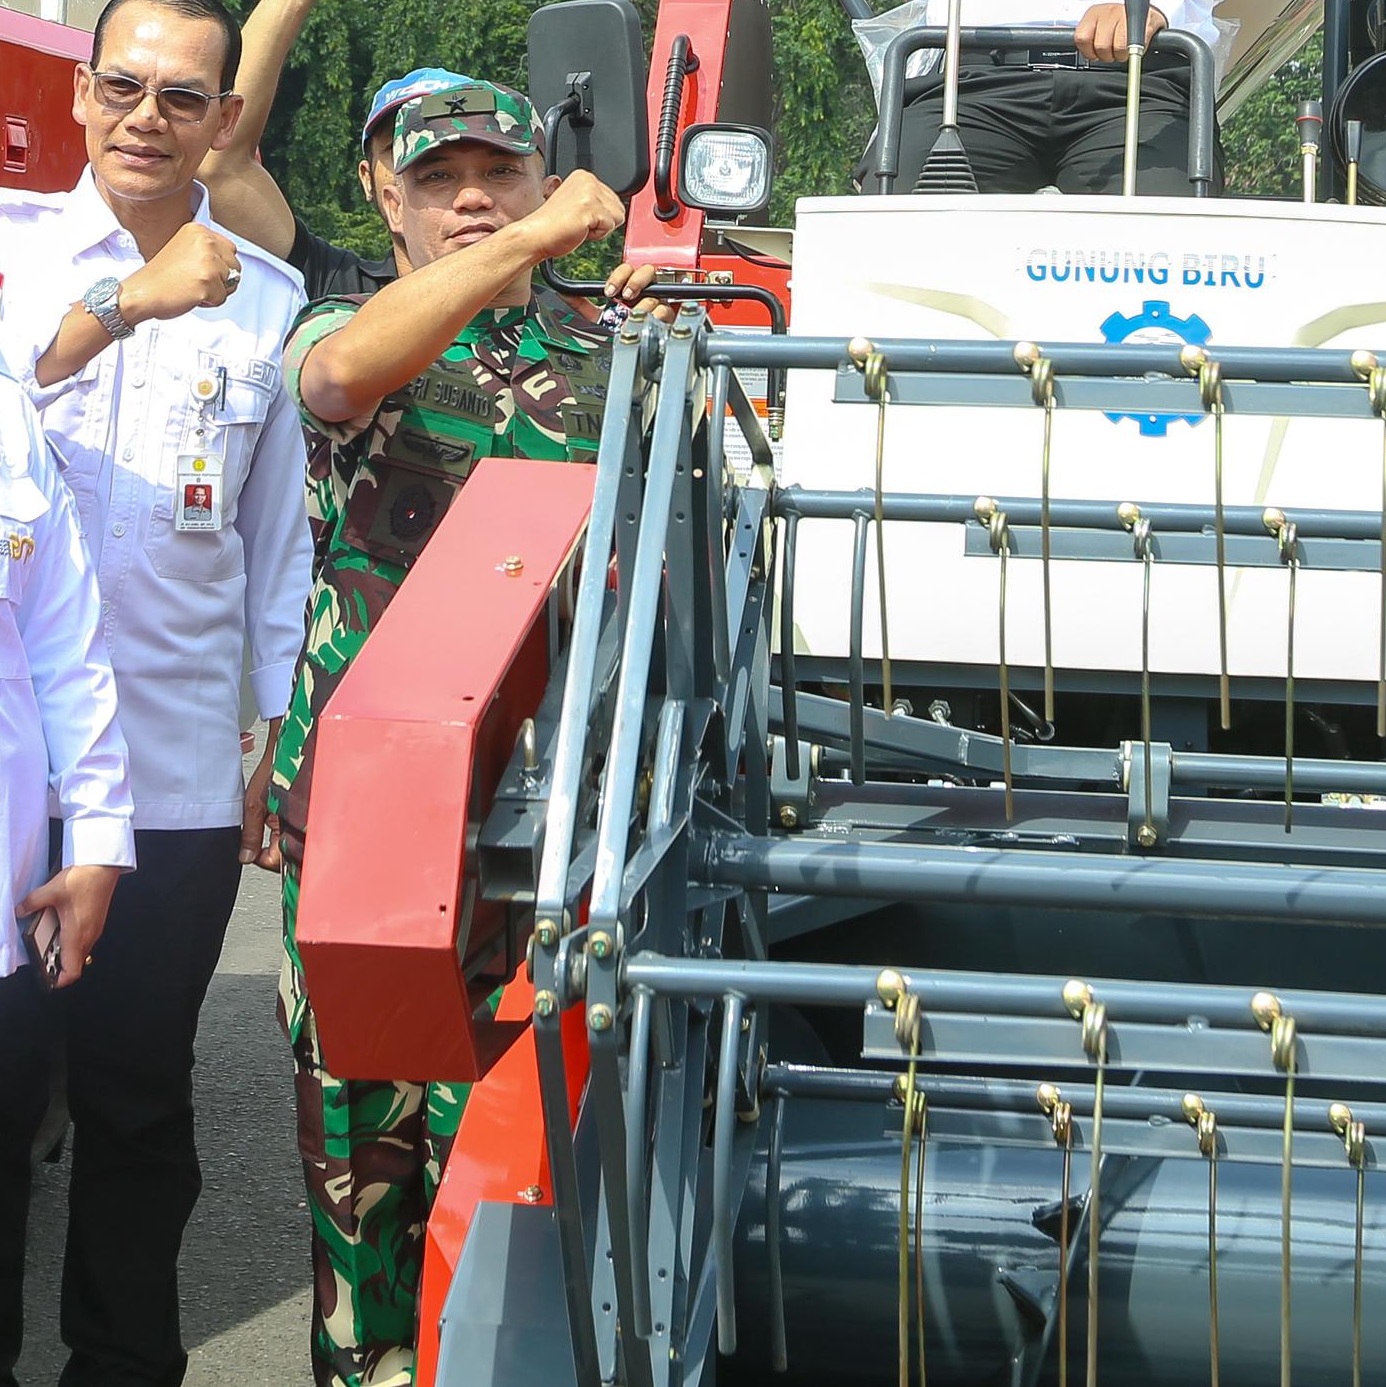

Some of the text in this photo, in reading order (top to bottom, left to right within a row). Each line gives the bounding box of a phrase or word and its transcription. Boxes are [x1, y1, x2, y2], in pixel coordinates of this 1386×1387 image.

[1026, 248, 1266, 289] GUNUNG BIRU
[434, 380, 491, 417] SUSANTO
[570, 410, 602, 434] TN
